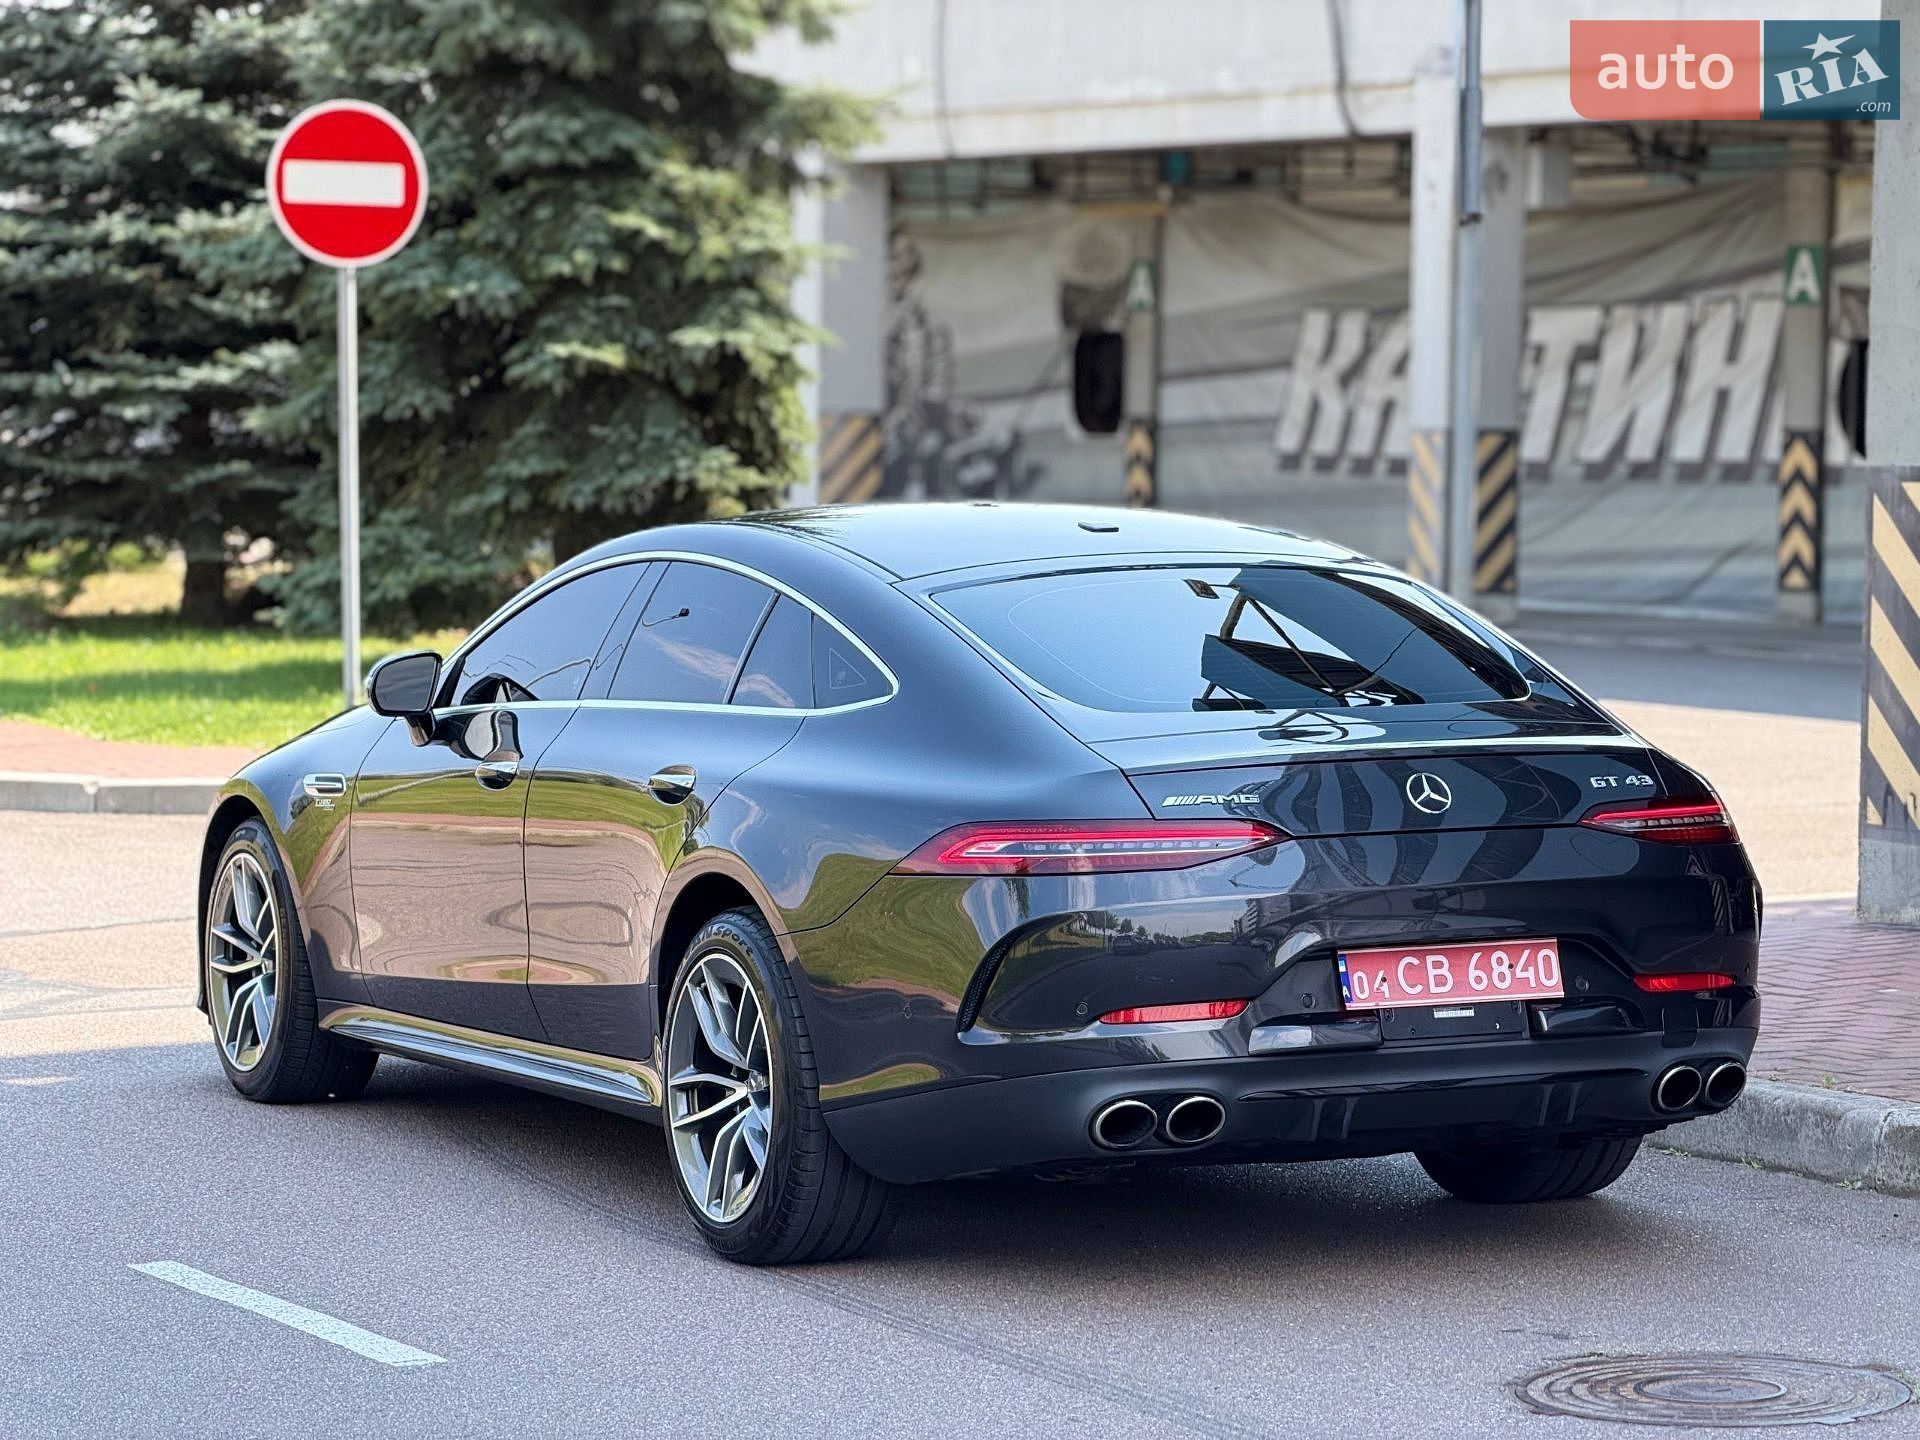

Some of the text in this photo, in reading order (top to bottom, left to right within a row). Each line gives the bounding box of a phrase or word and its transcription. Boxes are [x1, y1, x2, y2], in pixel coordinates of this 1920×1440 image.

[1787, 248, 1821, 301] A
[1590, 775, 1654, 789] GT 43
[1194, 794, 1261, 805] AMG
[1353, 948, 1560, 1000] 04 CB 6840
